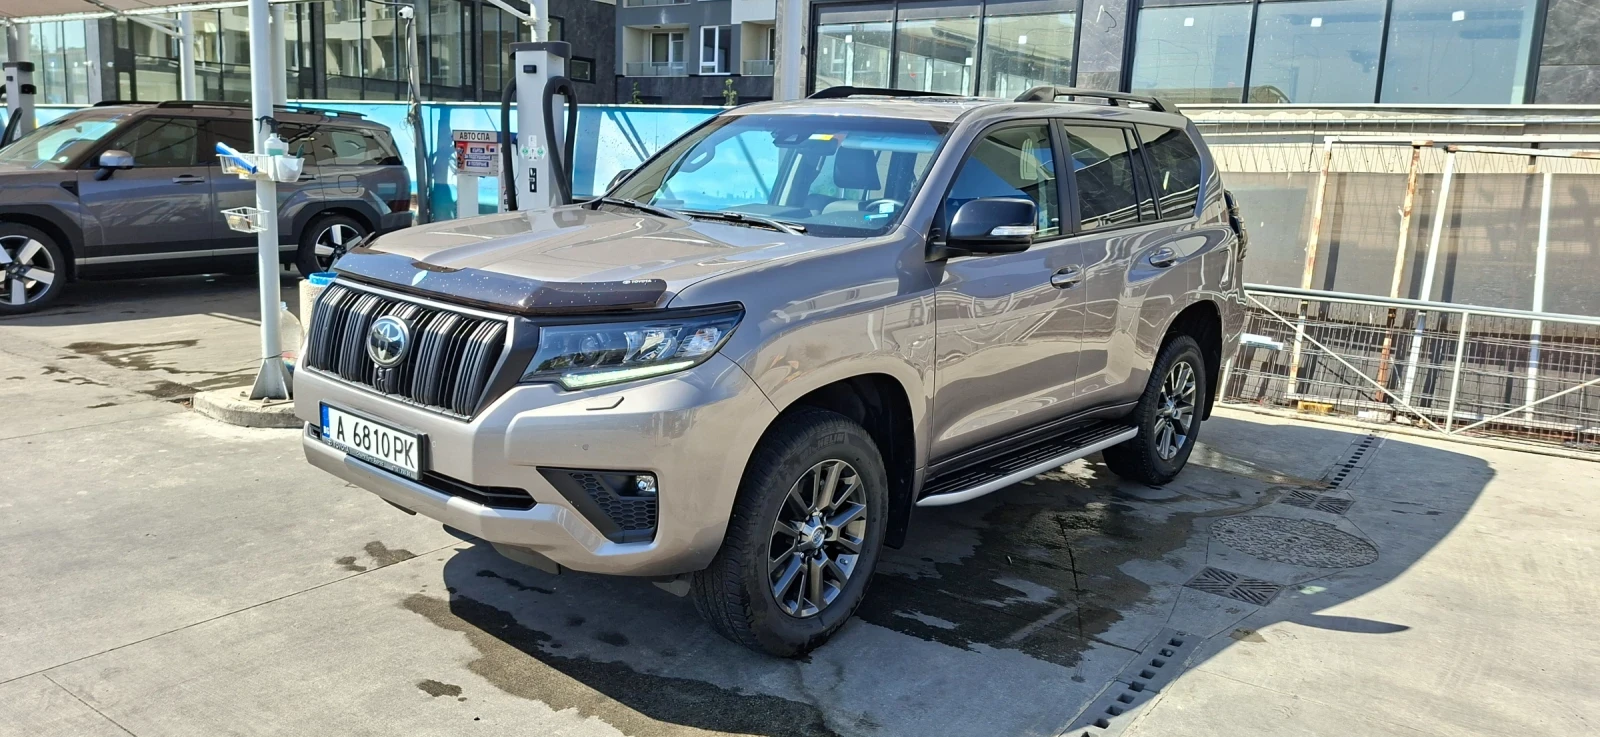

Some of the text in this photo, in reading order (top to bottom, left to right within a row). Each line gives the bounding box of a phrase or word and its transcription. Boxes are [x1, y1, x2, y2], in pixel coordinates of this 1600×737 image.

[459, 132, 490, 141] АВТО СПА
[336, 415, 346, 442] A
